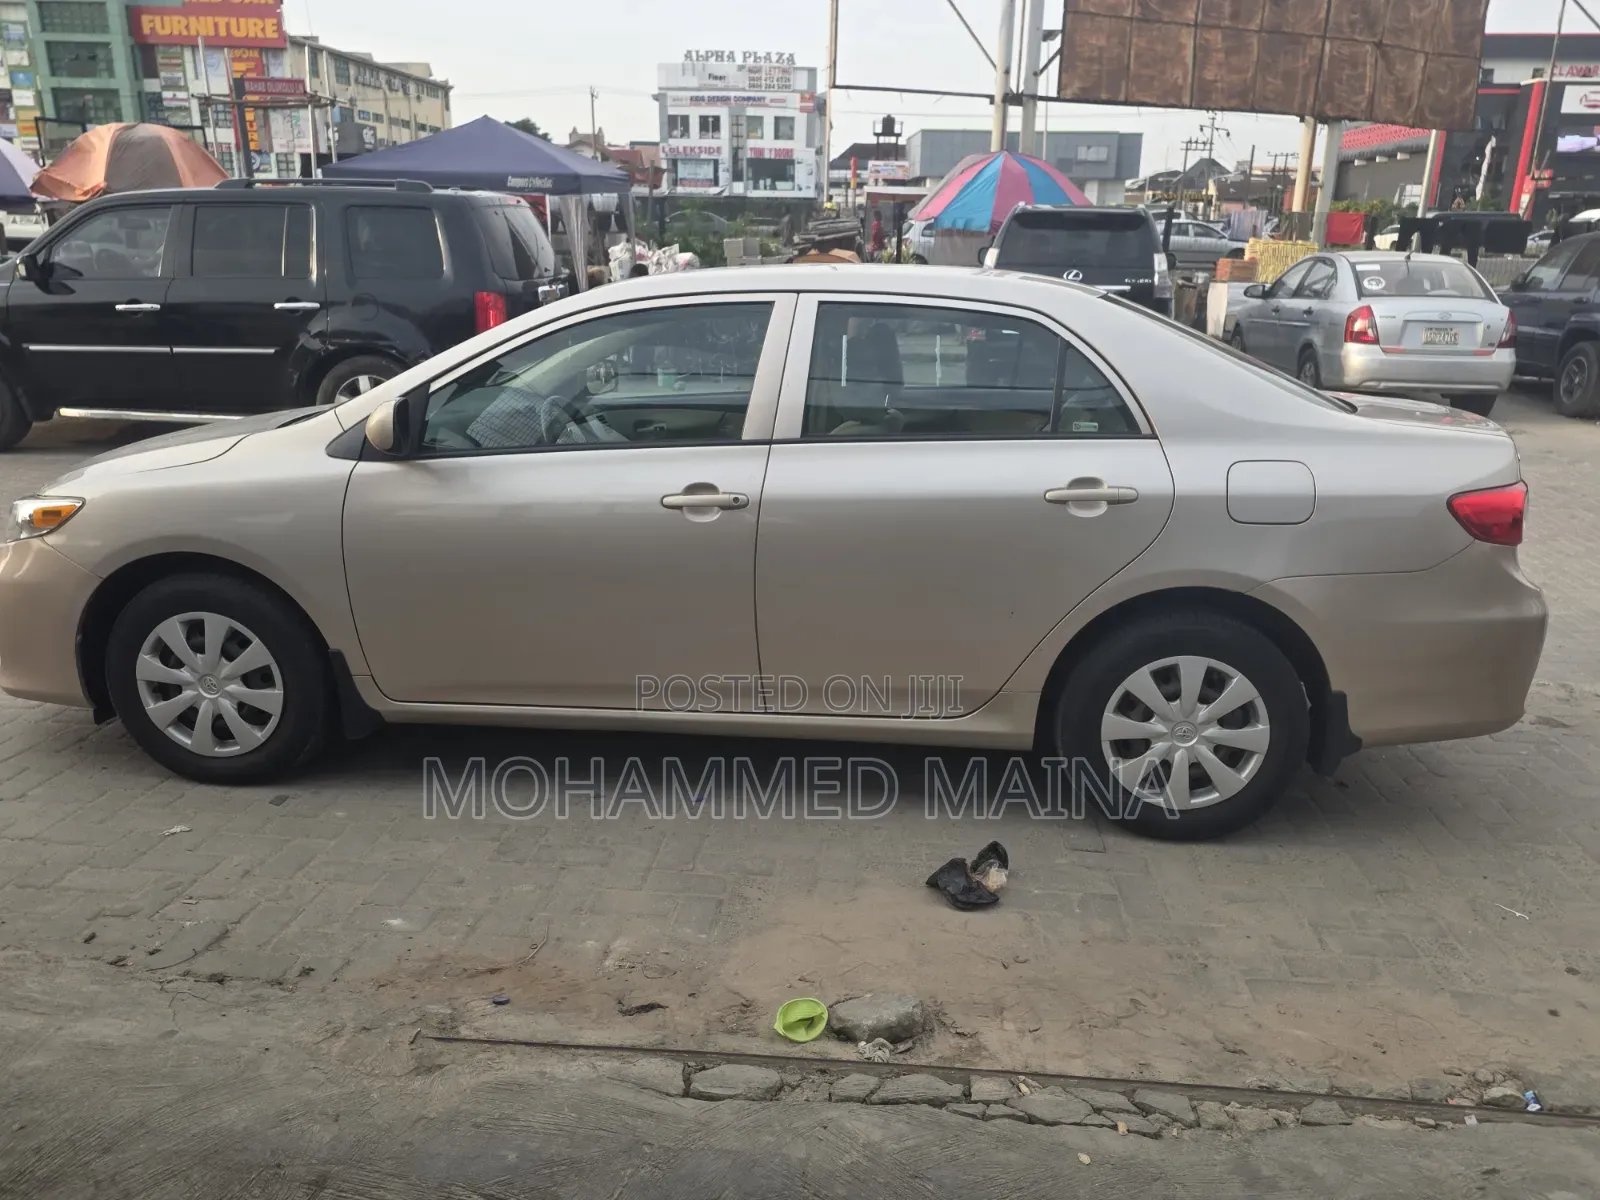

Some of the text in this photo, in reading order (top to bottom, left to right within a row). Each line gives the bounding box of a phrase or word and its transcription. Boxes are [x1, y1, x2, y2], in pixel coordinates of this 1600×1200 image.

[141, 14, 279, 39] FURNITURE
[684, 50, 796, 65] ALPHA PLAZA
[707, 95, 731, 103] DESIGN
[733, 96, 766, 104] COMPANY
